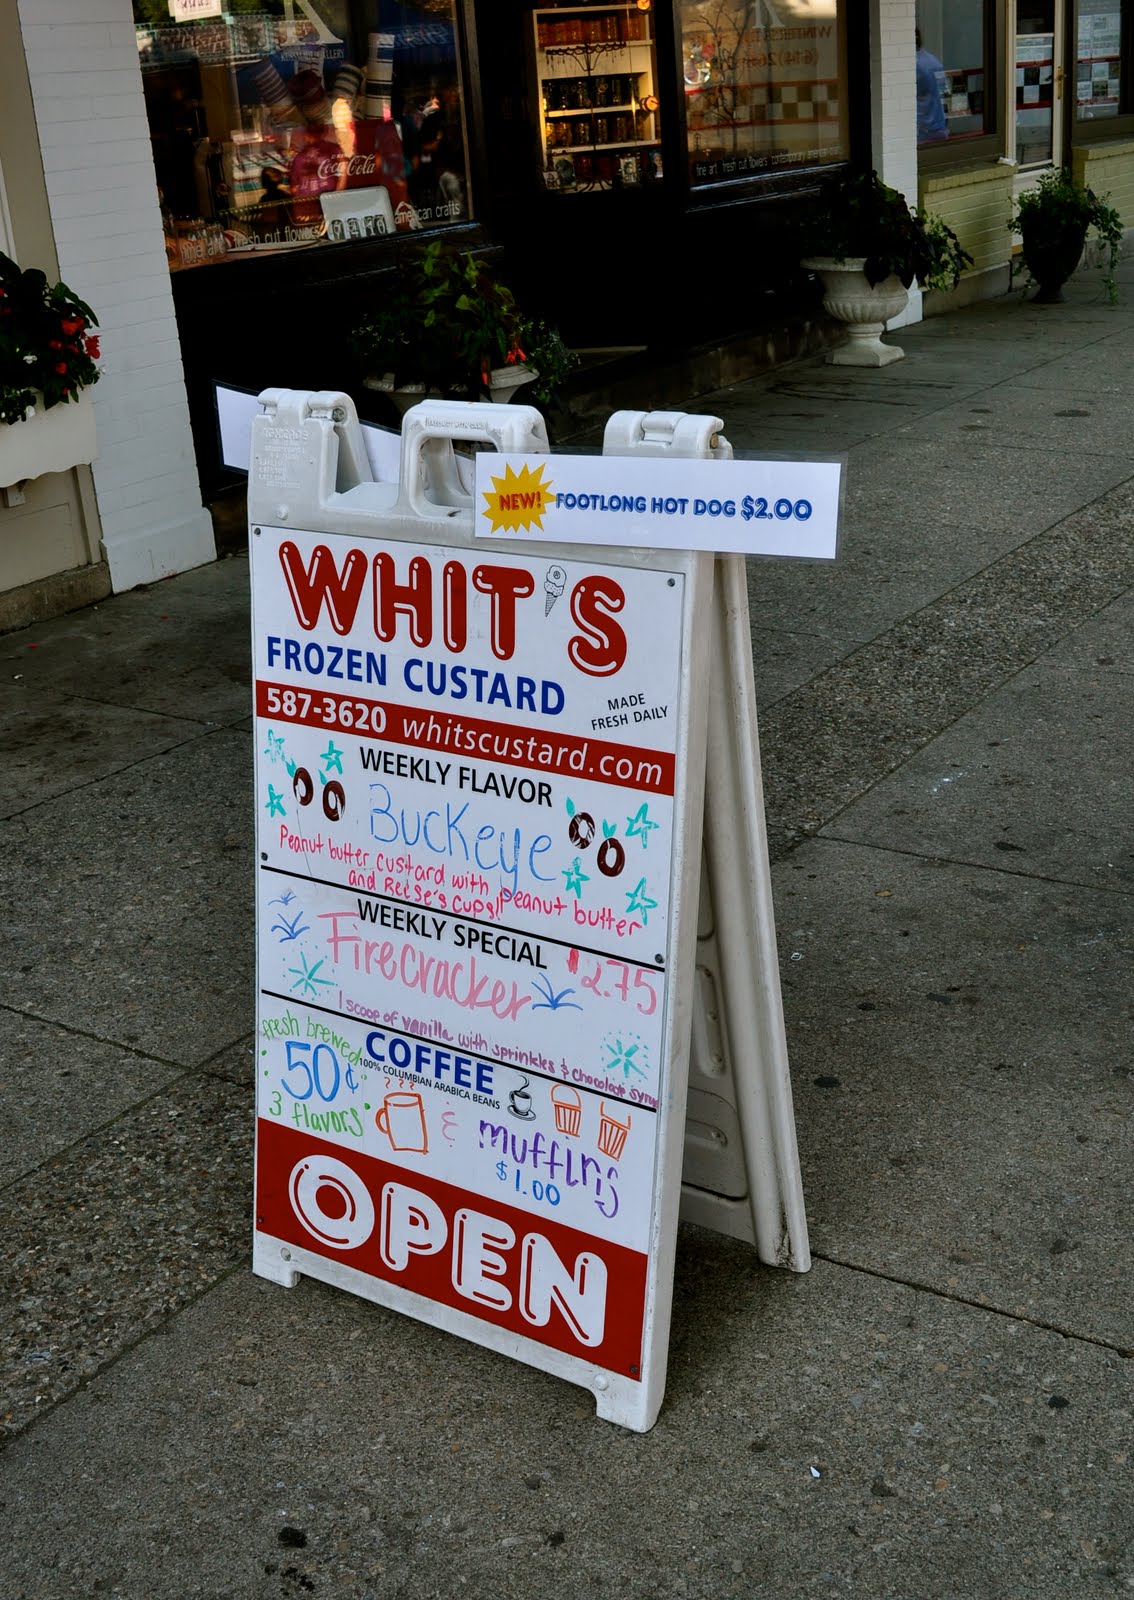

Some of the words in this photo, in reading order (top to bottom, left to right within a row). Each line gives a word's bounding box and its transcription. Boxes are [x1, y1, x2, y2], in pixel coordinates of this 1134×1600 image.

[264, 229, 281, 245] cut
[394, 206, 433, 225] amecan
[435, 199, 461, 218] crafts
[499, 490, 542, 511] NEW!
[555, 492, 647, 514] FOOTLONG
[650, 497, 689, 515] HOT
[694, 498, 736, 517] DOG
[740, 494, 813, 521] $2.00
[267, 635, 388, 686] FROZEN
[403, 658, 566, 716] CUSTARD
[607, 692, 647, 711] MADE
[266, 688, 388, 733] 587-3620
[402, 717, 663, 786] whitscustard.com
[590, 712, 630, 731] FRESH
[634, 705, 669, 724] DAILY
[359, 746, 452, 786] WEEKLY
[458, 766, 553, 808] FLAVOR
[280, 823, 324, 853] Peanut
[328, 837, 370, 867] butter
[452, 871, 489, 896] with
[348, 869, 376, 891] and
[574, 899, 643, 938] butter
[357, 898, 447, 942] WEEKLY
[453, 924, 548, 970] SPECIAL
[262, 1008, 300, 1041] fresh
[306, 1016, 363, 1067] brewed
[346, 999, 381, 1022] scoop
[383, 1010, 399, 1027] of
[402, 1015, 454, 1042] vanilla
[458, 1031, 488, 1052] with
[491, 1044, 556, 1074] sprinkles
[365, 1031, 495, 1096] COFFEE
[269, 1090, 282, 1117] 3
[292, 1102, 364, 1138] flavors
[358, 1057, 381, 1073] 100%
[382, 1065, 433, 1089] COLUMBIAN
[434, 1081, 471, 1101] ARABICA
[472, 1093, 501, 1111] BEANS
[496, 1160, 561, 1206] $1.00
[288, 1154, 608, 1348] OPEN
